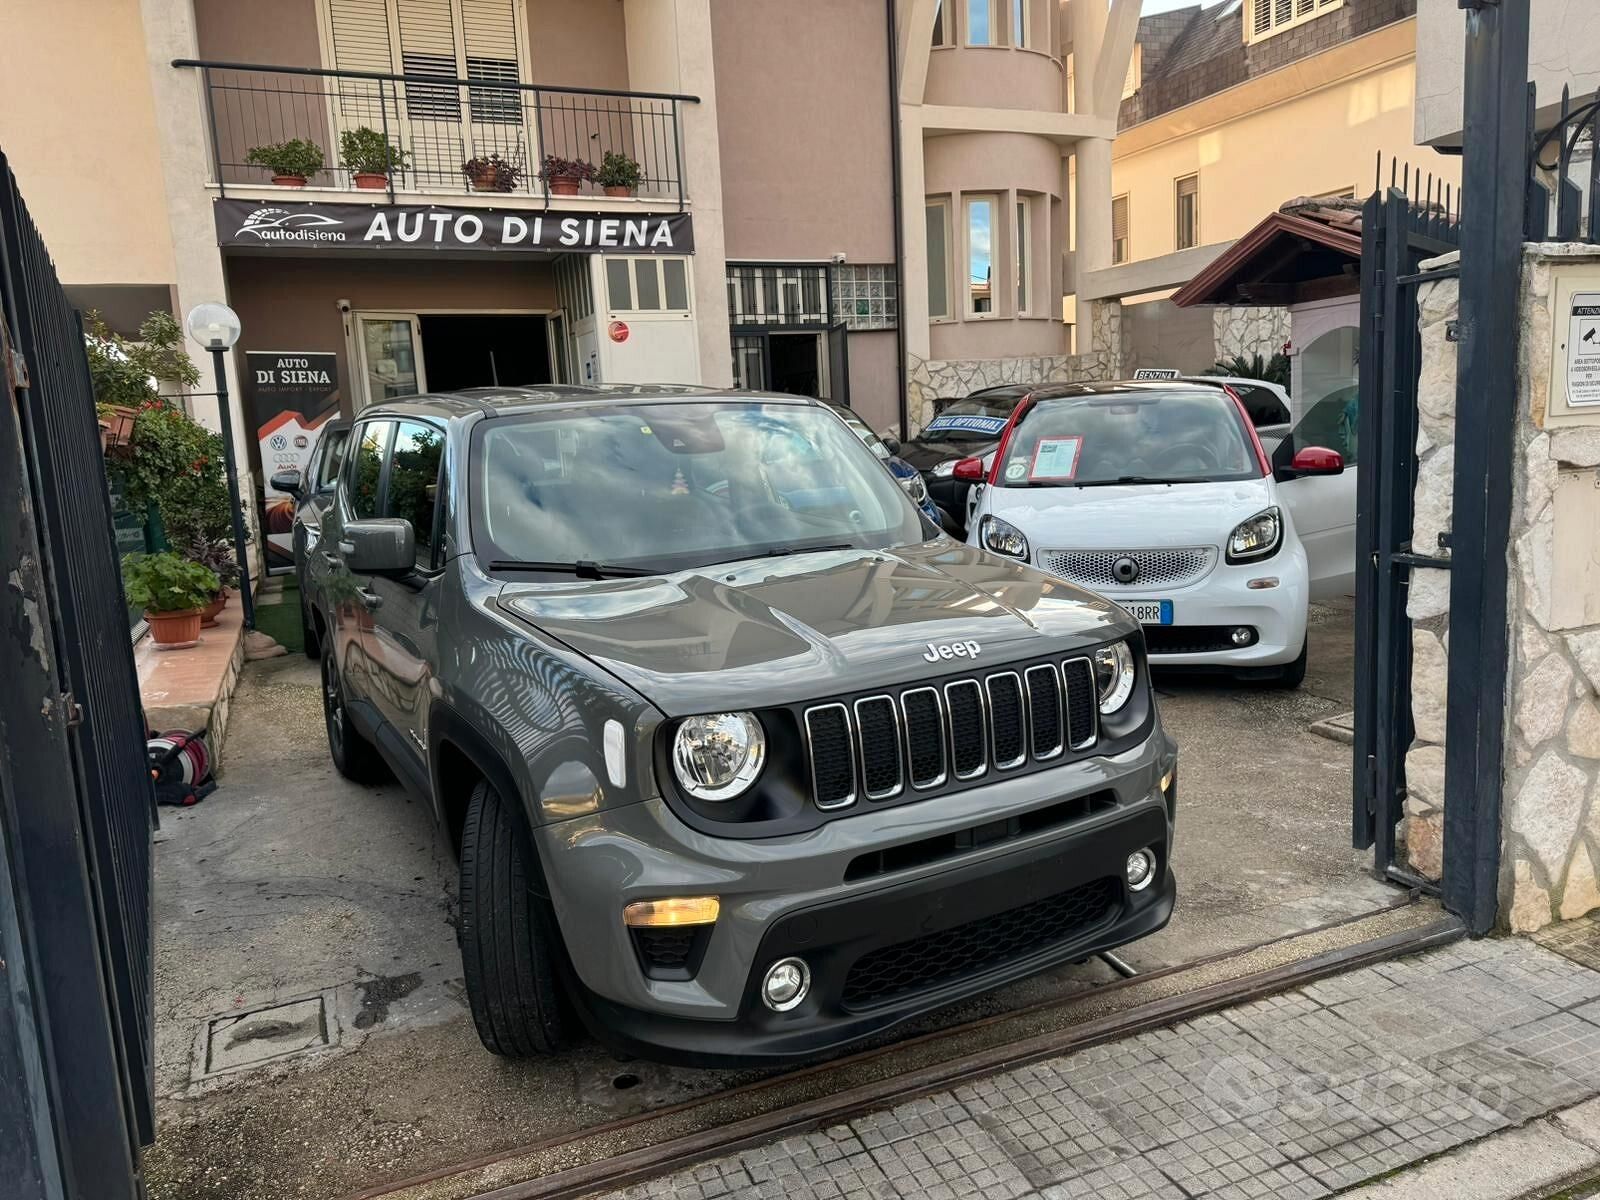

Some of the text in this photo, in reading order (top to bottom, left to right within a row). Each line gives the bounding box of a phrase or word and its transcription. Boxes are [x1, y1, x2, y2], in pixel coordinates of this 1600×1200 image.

[261, 228, 346, 243] autodisiena
[363, 211, 674, 247] AUTO DI SIENA
[276, 358, 309, 369] AUTO
[256, 370, 332, 384] DI SIENA
[1138, 371, 1173, 380] BENZINA
[933, 417, 1000, 430] FULL OPTIONAL
[1125, 606, 1160, 620] 18RR
[922, 640, 981, 662] Jeep
